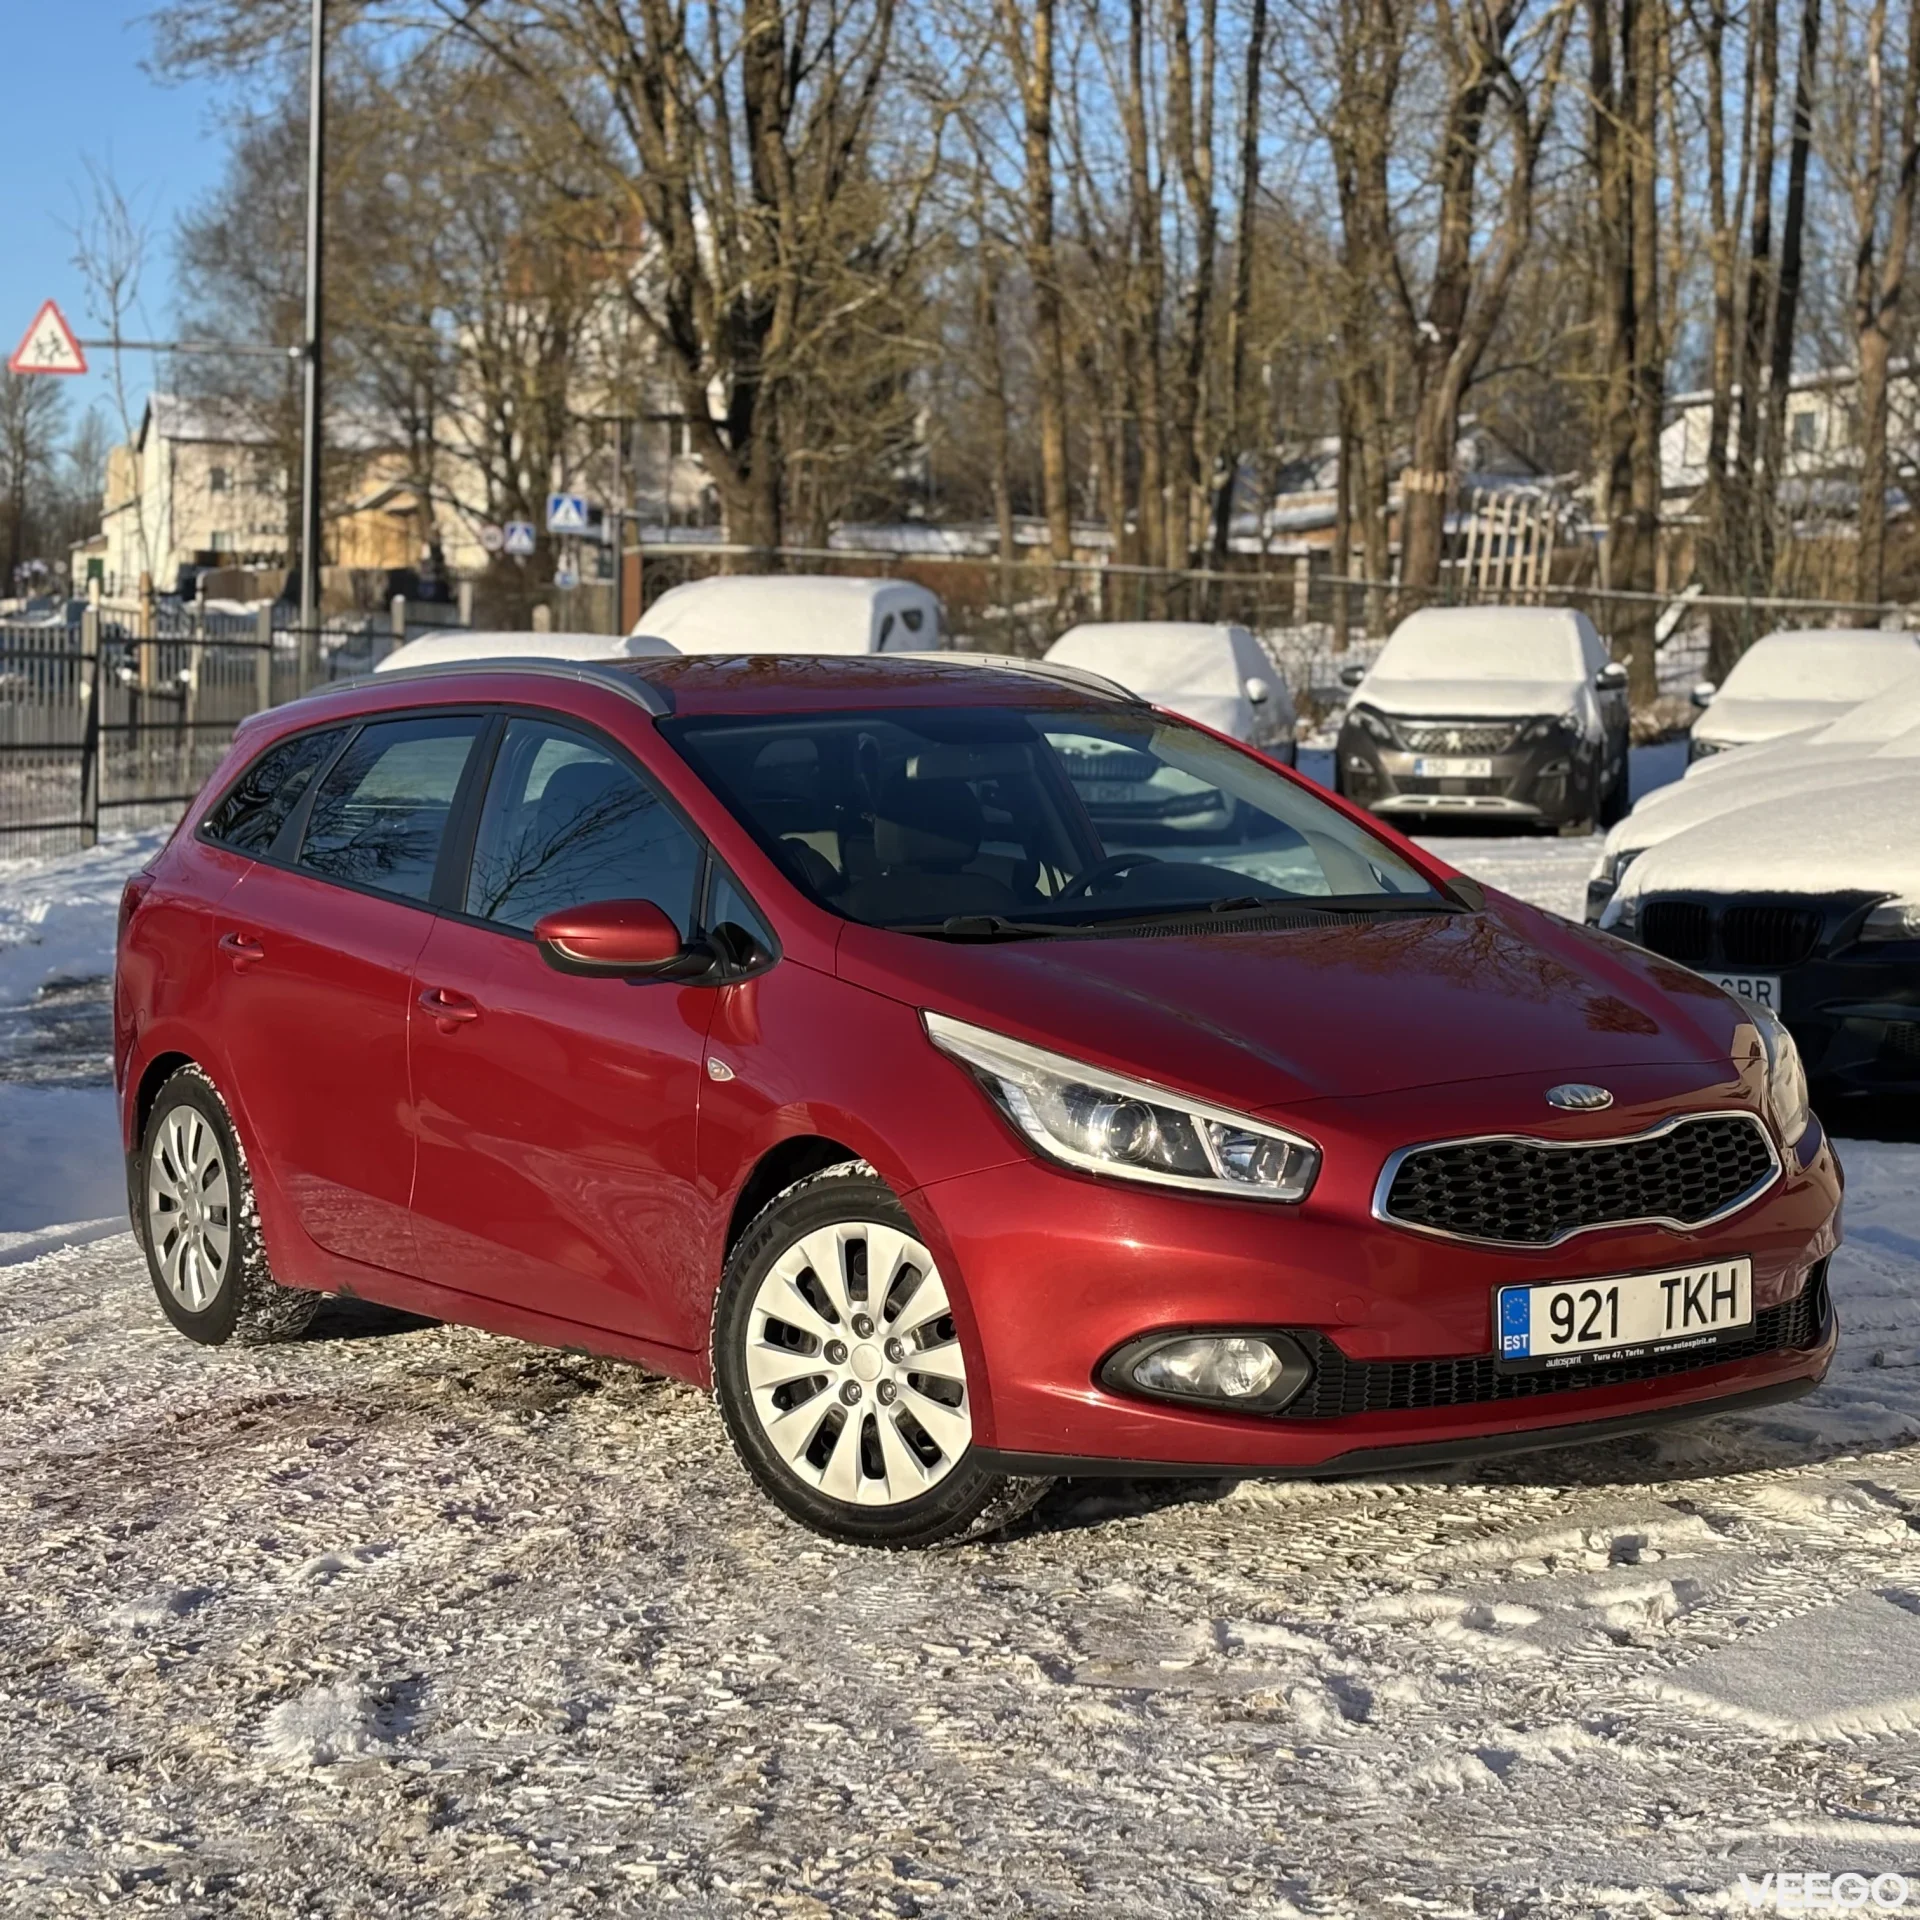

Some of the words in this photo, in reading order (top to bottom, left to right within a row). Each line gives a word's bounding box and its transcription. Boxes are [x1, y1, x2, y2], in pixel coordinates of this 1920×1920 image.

[1556, 1087, 1608, 1106] KIA
[1550, 1286, 1619, 1344] 921
[1660, 1268, 1737, 1331] TKH
[1504, 1333, 1529, 1351] EST
[1653, 1336, 1717, 1353] www.autospirit.ee
[1545, 1354, 1582, 1368] autospirit
[1593, 1352, 1611, 1362] Turu
[1611, 1350, 1624, 1360] 47,
[1624, 1348, 1645, 1358] Tartu
